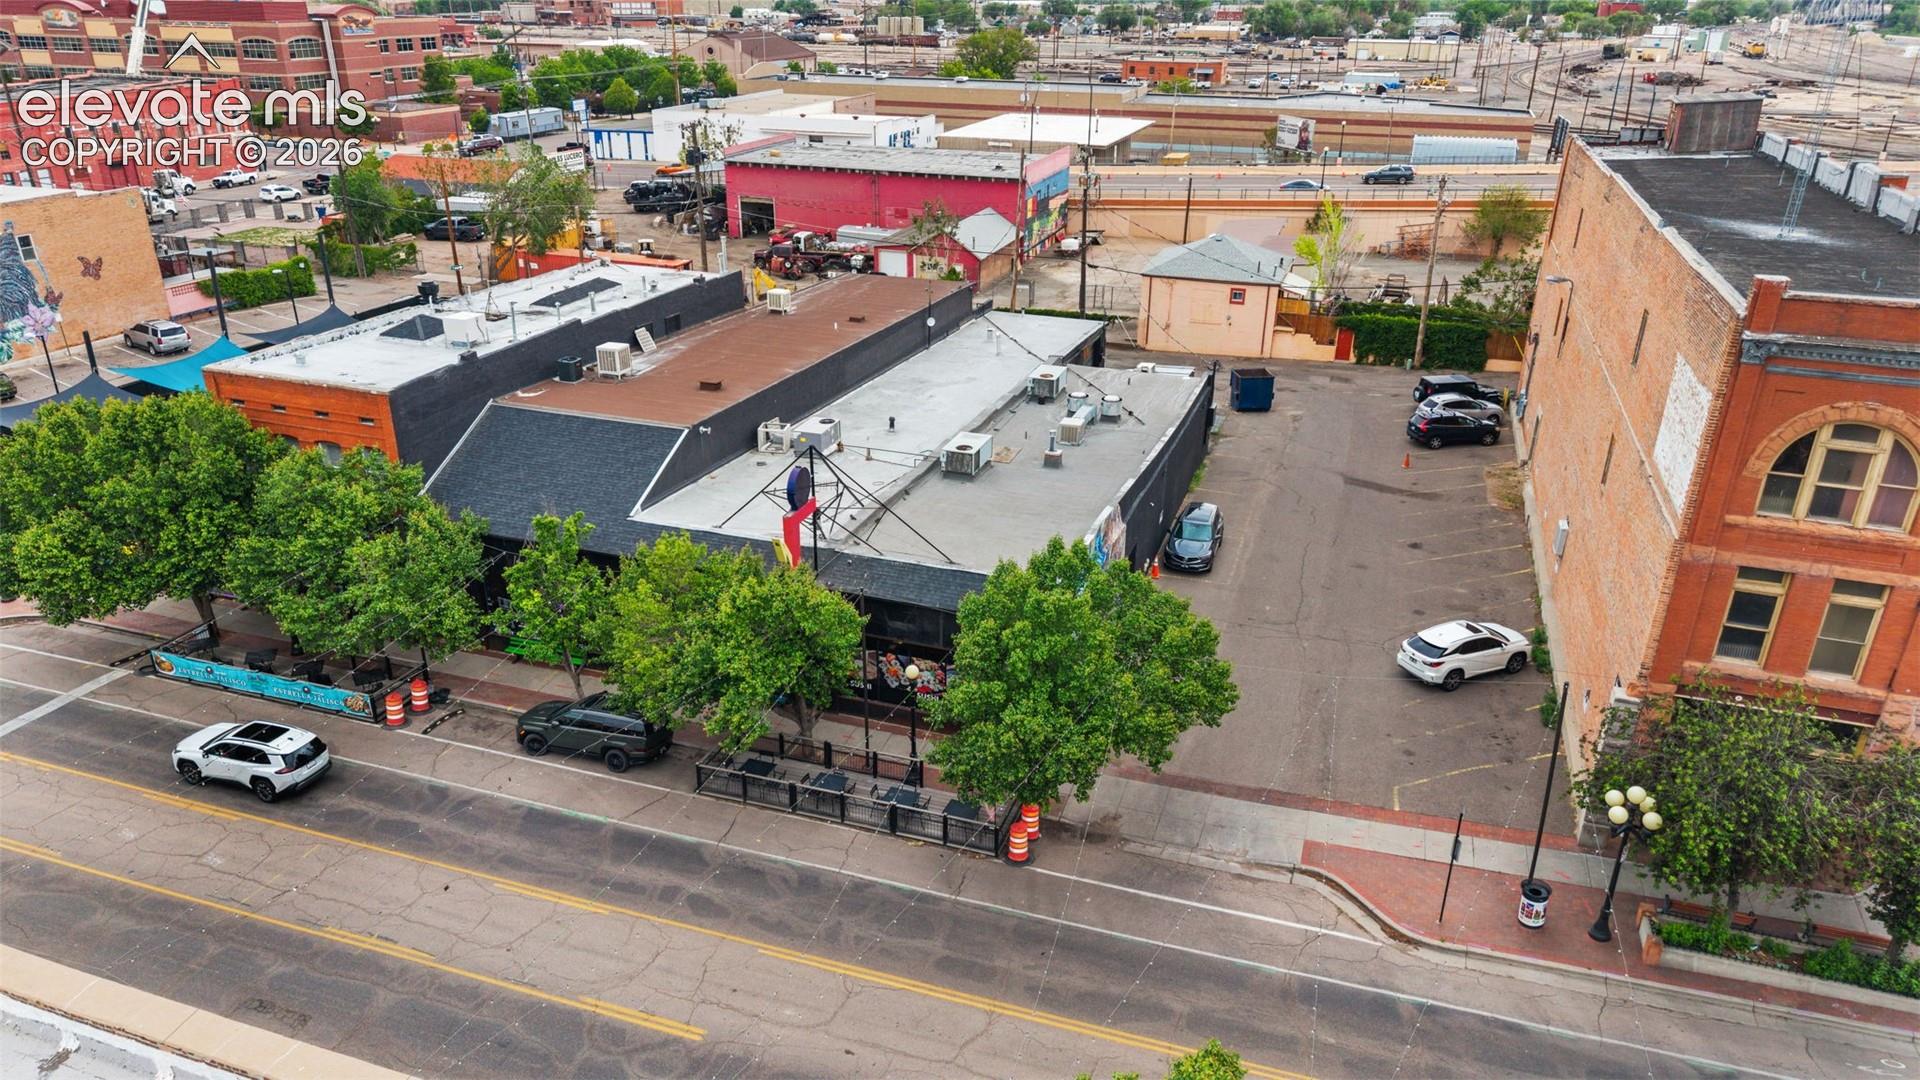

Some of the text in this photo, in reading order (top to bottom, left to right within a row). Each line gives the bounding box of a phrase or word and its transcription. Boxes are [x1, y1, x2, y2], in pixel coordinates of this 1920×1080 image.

[178, 667, 213, 678] ESTRELLA
[217, 675, 246, 686] JALISCO
[273, 687, 311, 699] ESTRELLA
